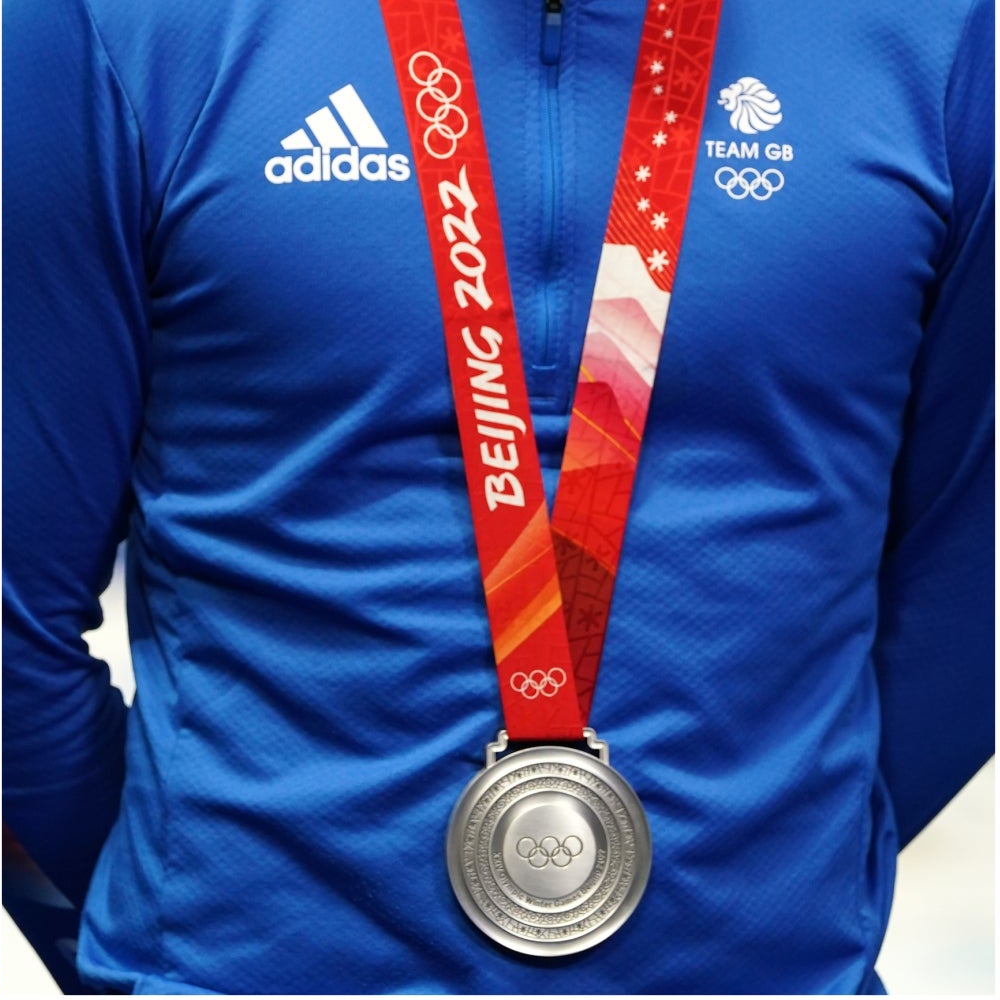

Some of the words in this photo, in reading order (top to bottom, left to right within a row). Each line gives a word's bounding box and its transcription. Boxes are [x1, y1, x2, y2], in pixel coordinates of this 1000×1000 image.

[264, 146, 411, 184] adidas
[705, 140, 760, 160] TEAM
[764, 142, 794, 162] GB
[437, 165, 493, 311] 2022
[461, 326, 527, 511] BEIJING
